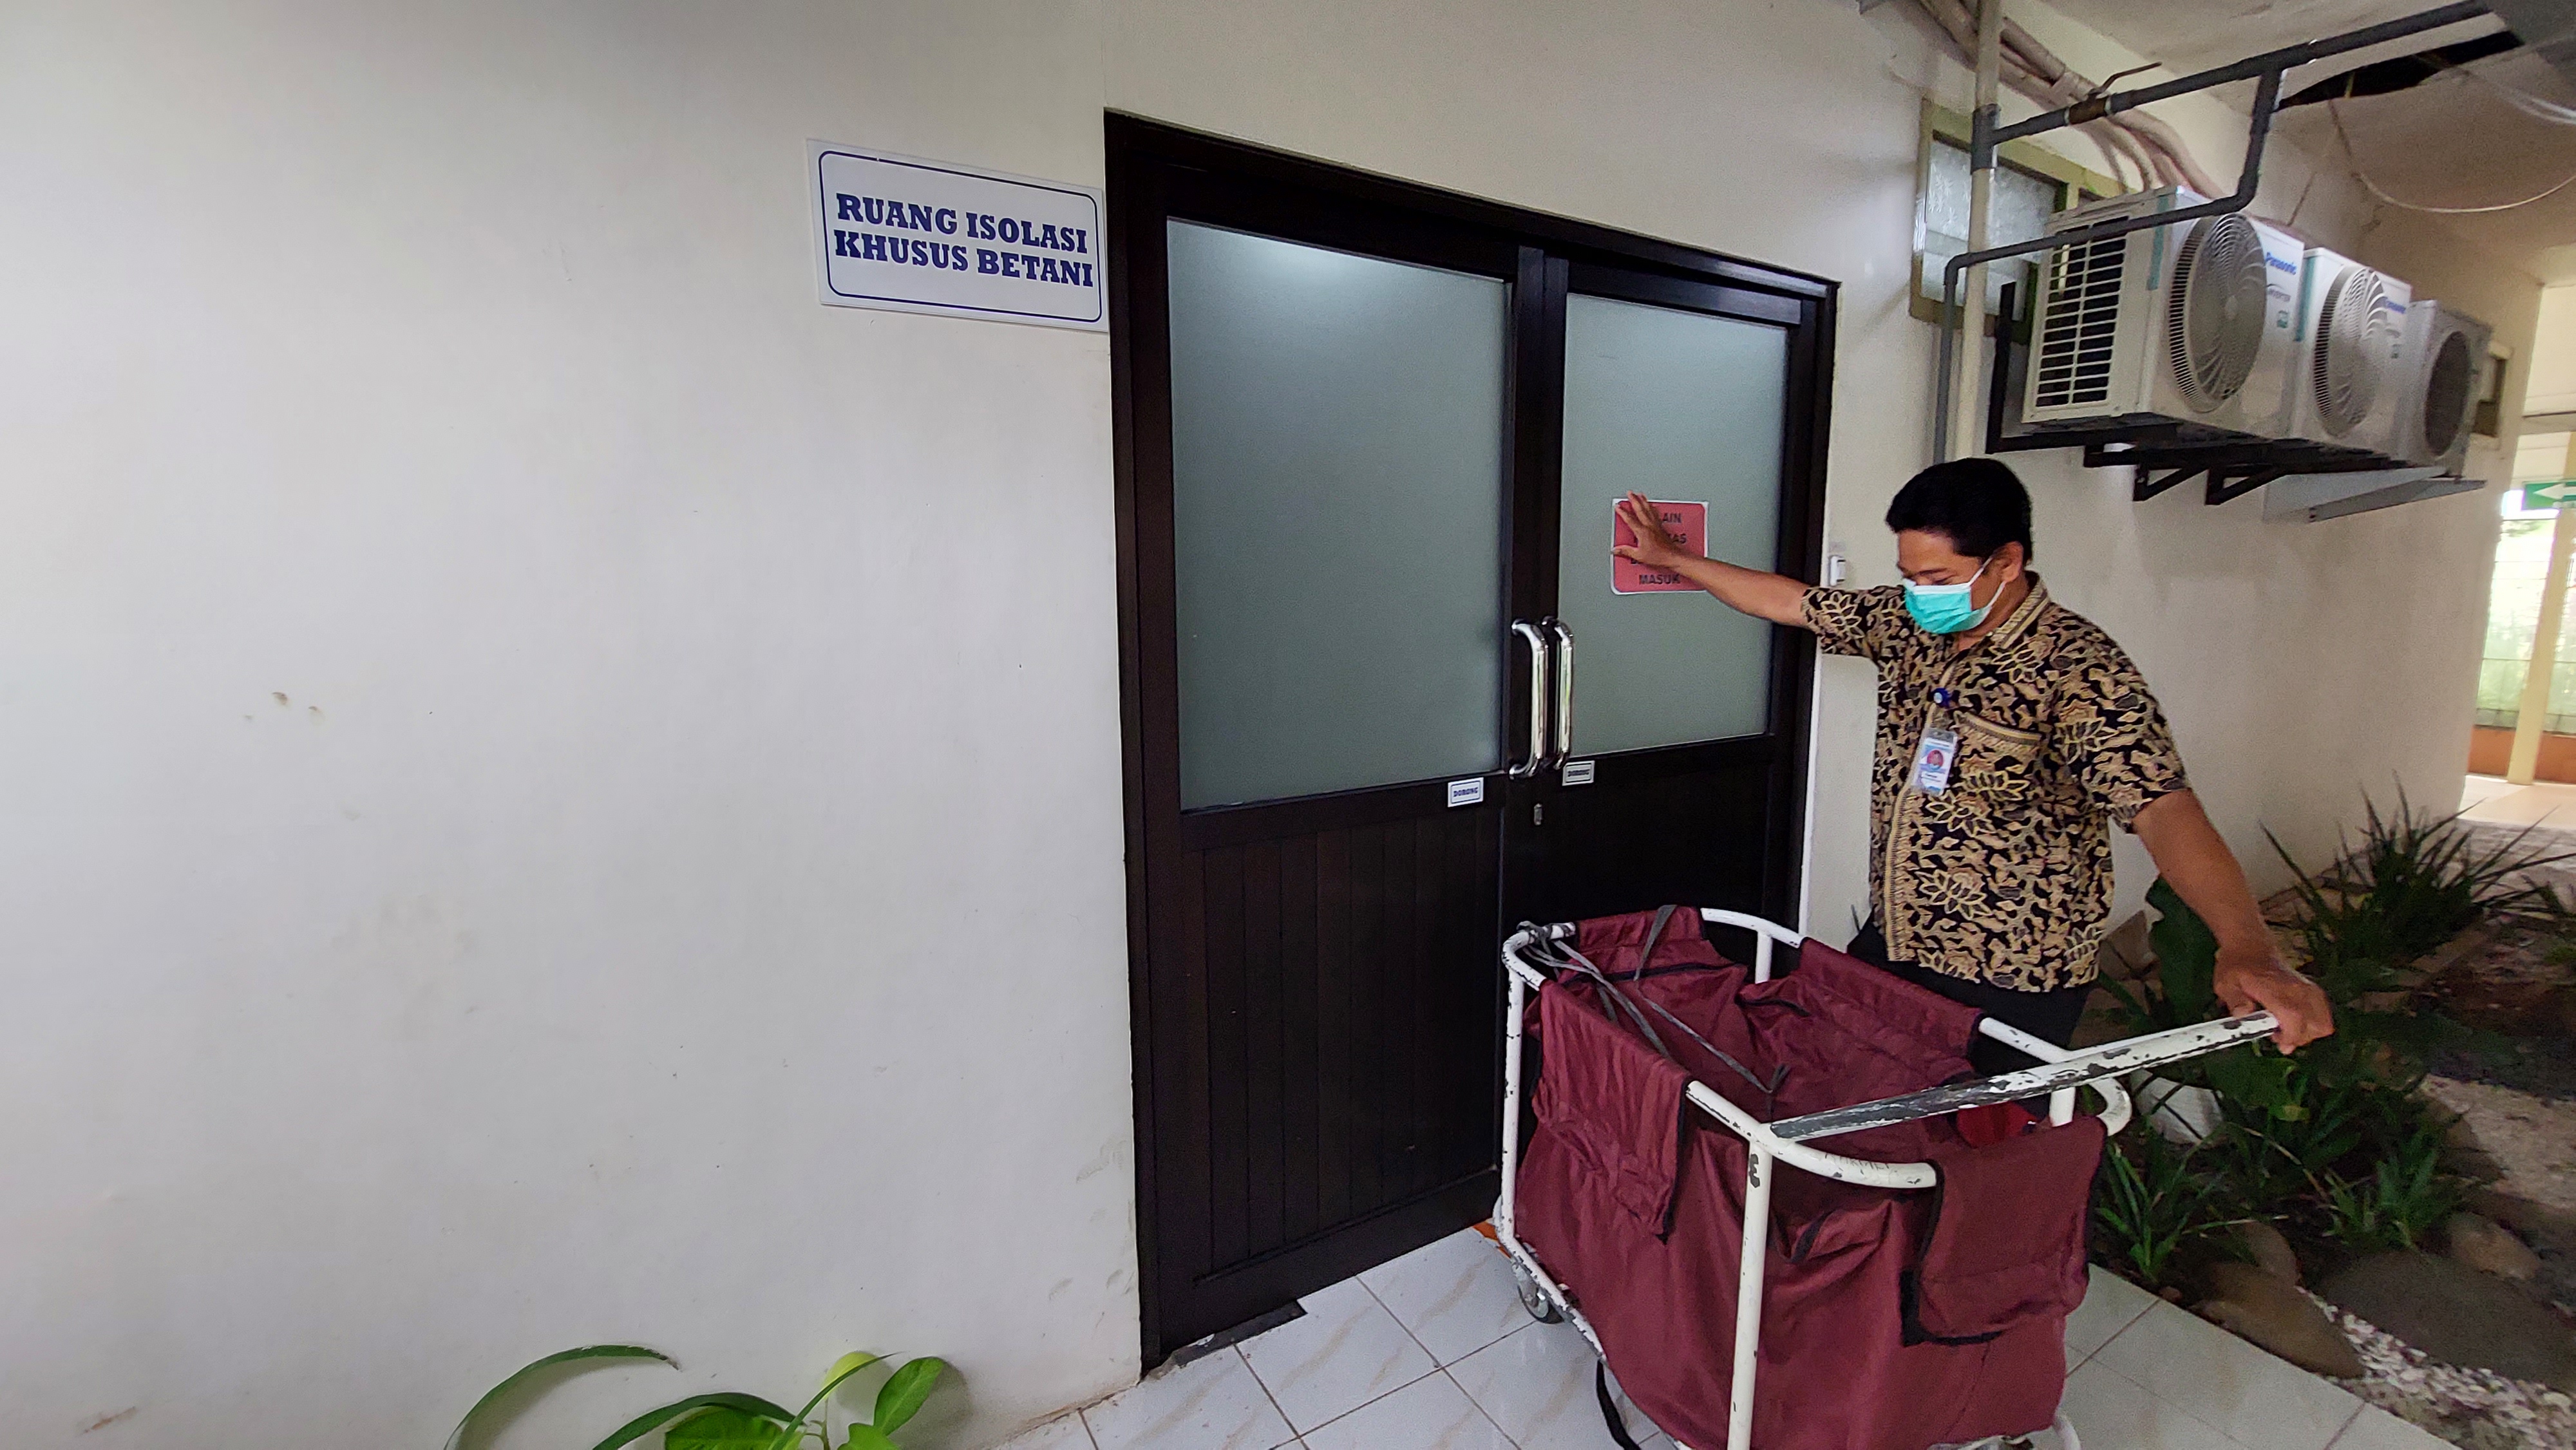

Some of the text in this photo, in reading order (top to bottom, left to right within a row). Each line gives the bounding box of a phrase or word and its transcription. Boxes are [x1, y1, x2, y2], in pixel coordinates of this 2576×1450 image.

[837, 193, 1087, 254] RUANG ISOLASI
[834, 229, 1094, 287] KHUSUS BETANI
[1639, 574, 1680, 585] MASUK
[1453, 787, 1479, 797] DORONG
